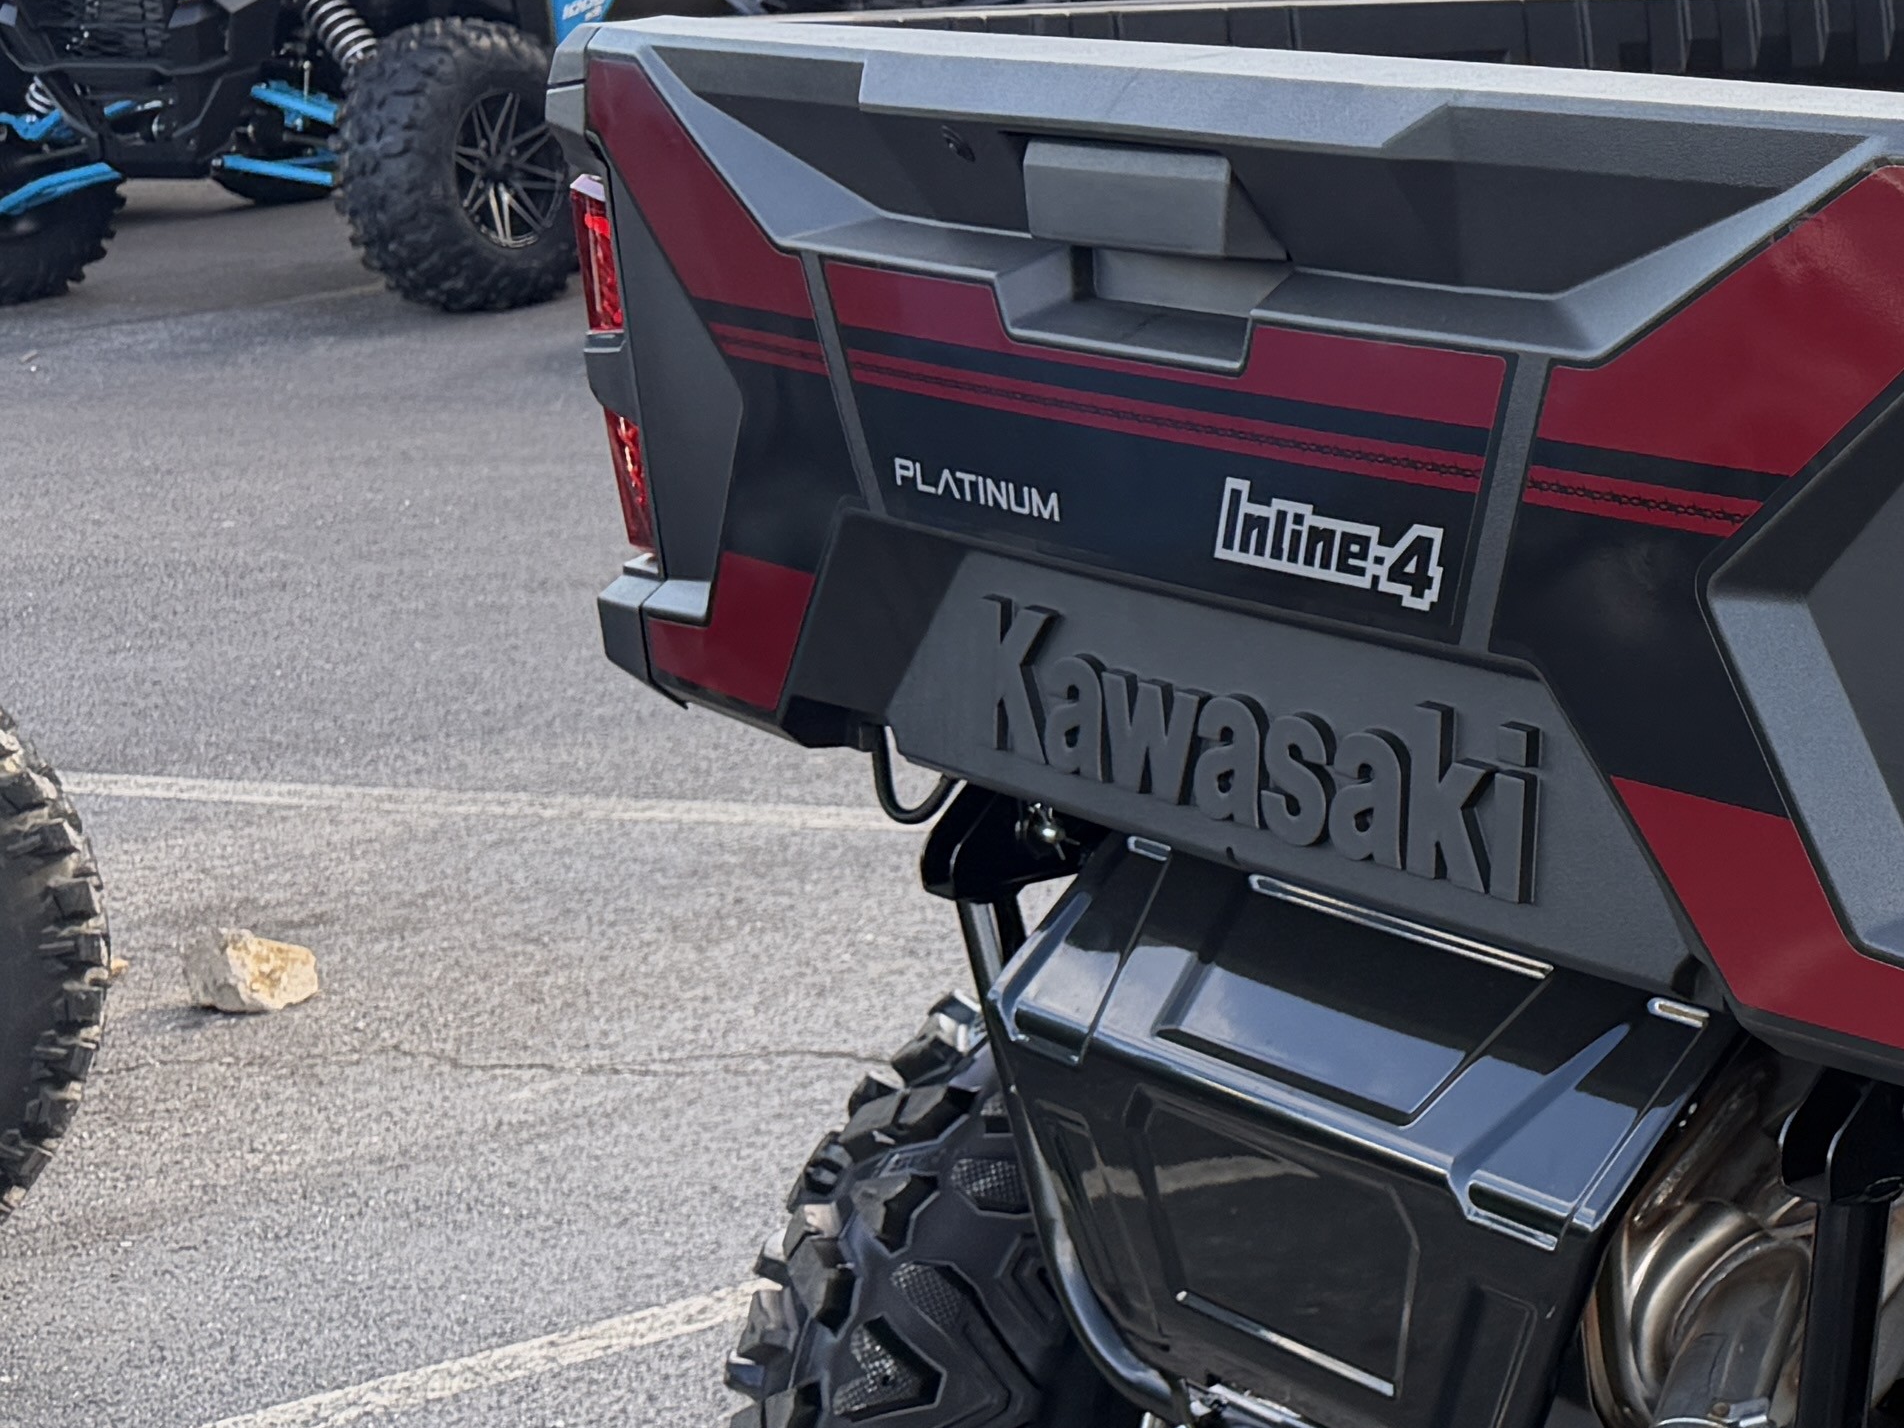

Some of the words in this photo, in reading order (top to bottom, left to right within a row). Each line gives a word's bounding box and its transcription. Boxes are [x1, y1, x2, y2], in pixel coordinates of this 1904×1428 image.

[894, 456, 1061, 523] PLATINUM
[1213, 476, 1444, 611] Inline-4
[983, 593, 1541, 904] Kawasaki
